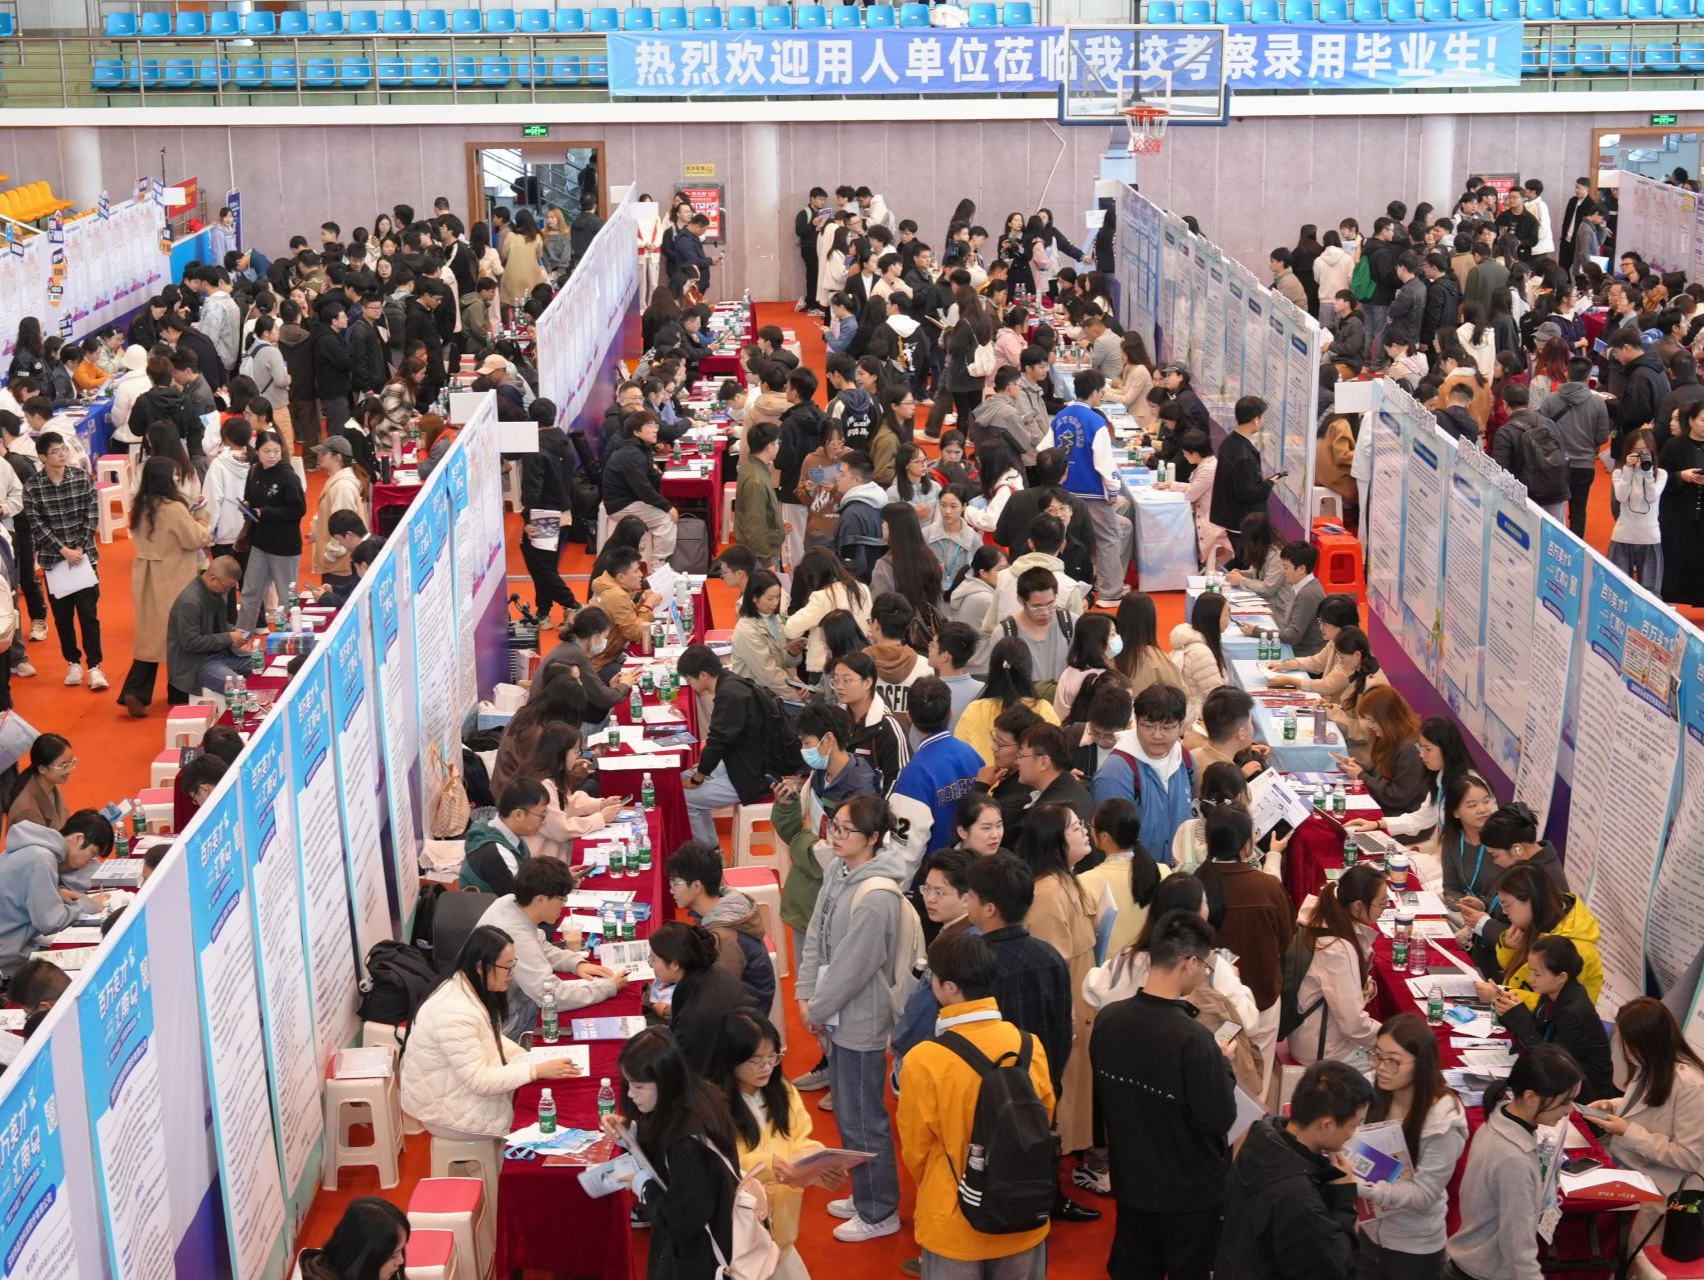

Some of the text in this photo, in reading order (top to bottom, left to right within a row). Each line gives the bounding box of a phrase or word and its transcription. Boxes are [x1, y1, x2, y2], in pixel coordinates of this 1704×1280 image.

[0, 1100, 28, 1172] 万英才
[12, 1123, 41, 1189] 汇南粤
